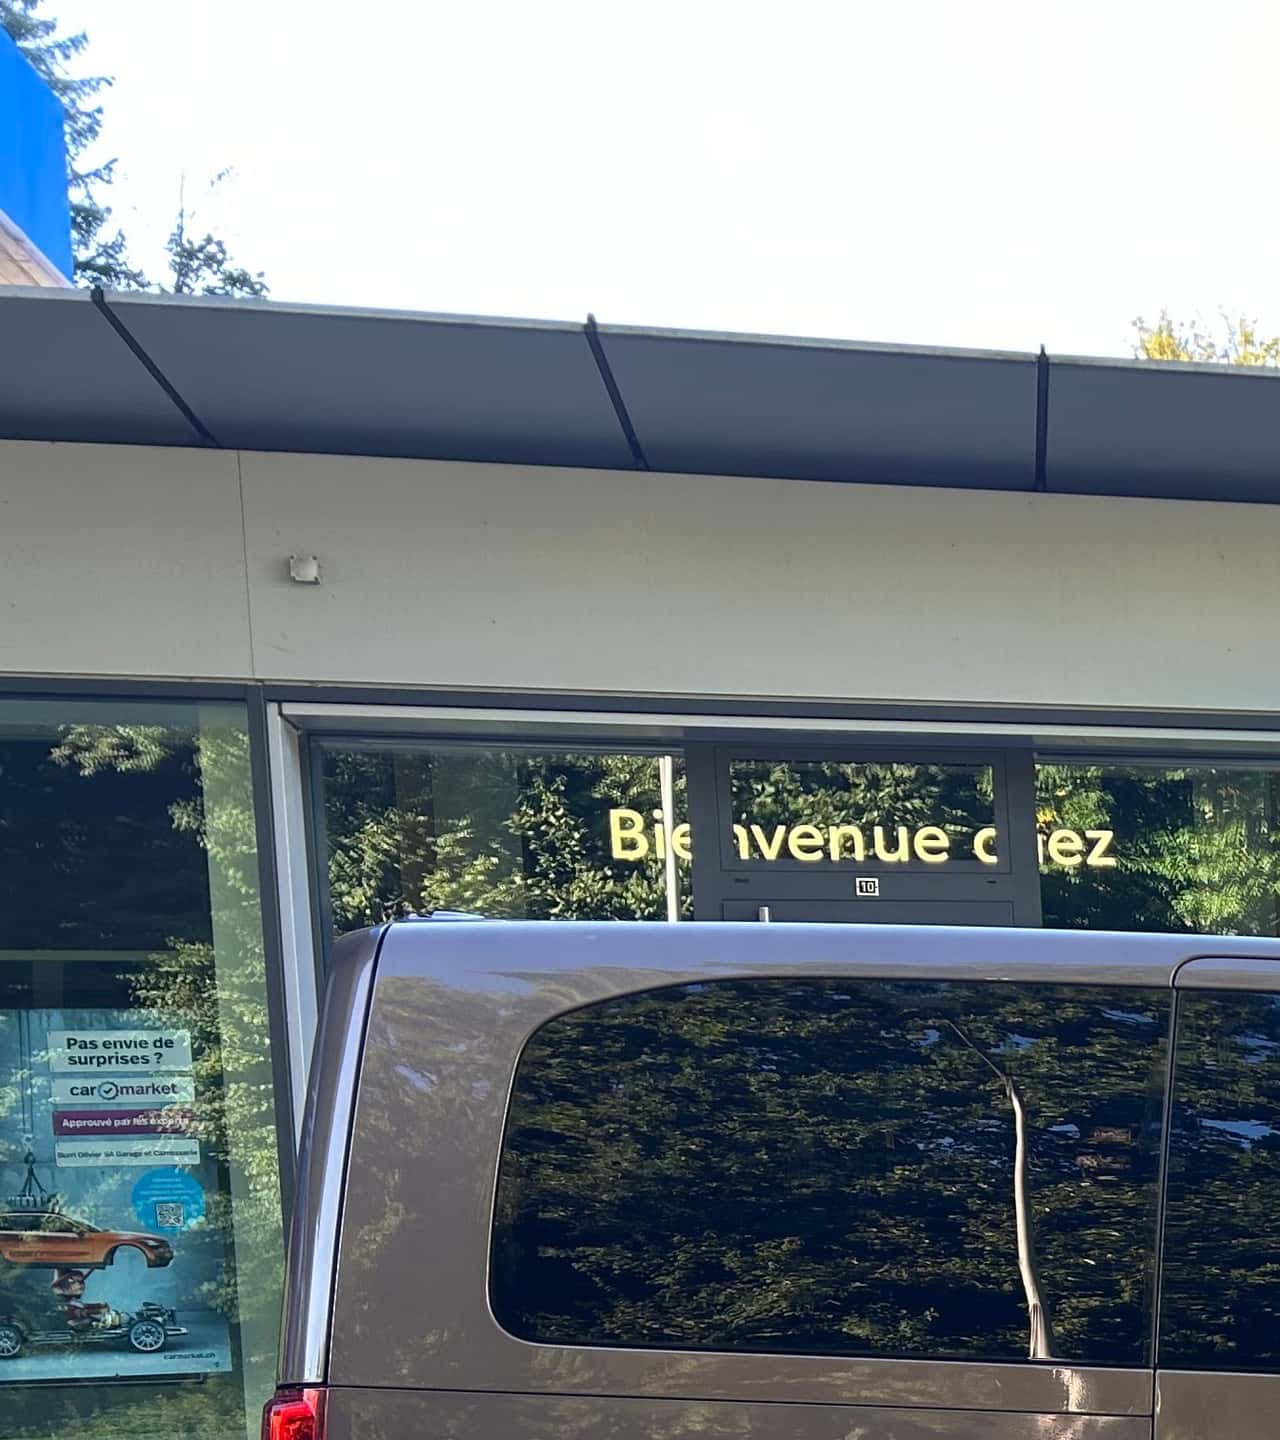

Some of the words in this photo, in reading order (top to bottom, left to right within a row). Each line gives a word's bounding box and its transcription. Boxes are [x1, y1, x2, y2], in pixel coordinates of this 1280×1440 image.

[860, 881, 875, 893] 10
[66, 1037, 99, 1050] Pas
[102, 1038, 149, 1050] envie
[153, 1036, 175, 1049] de
[68, 1051, 151, 1067] surprises
[62, 1118, 113, 1129] Approuvé
[114, 1118, 131, 1128] par
